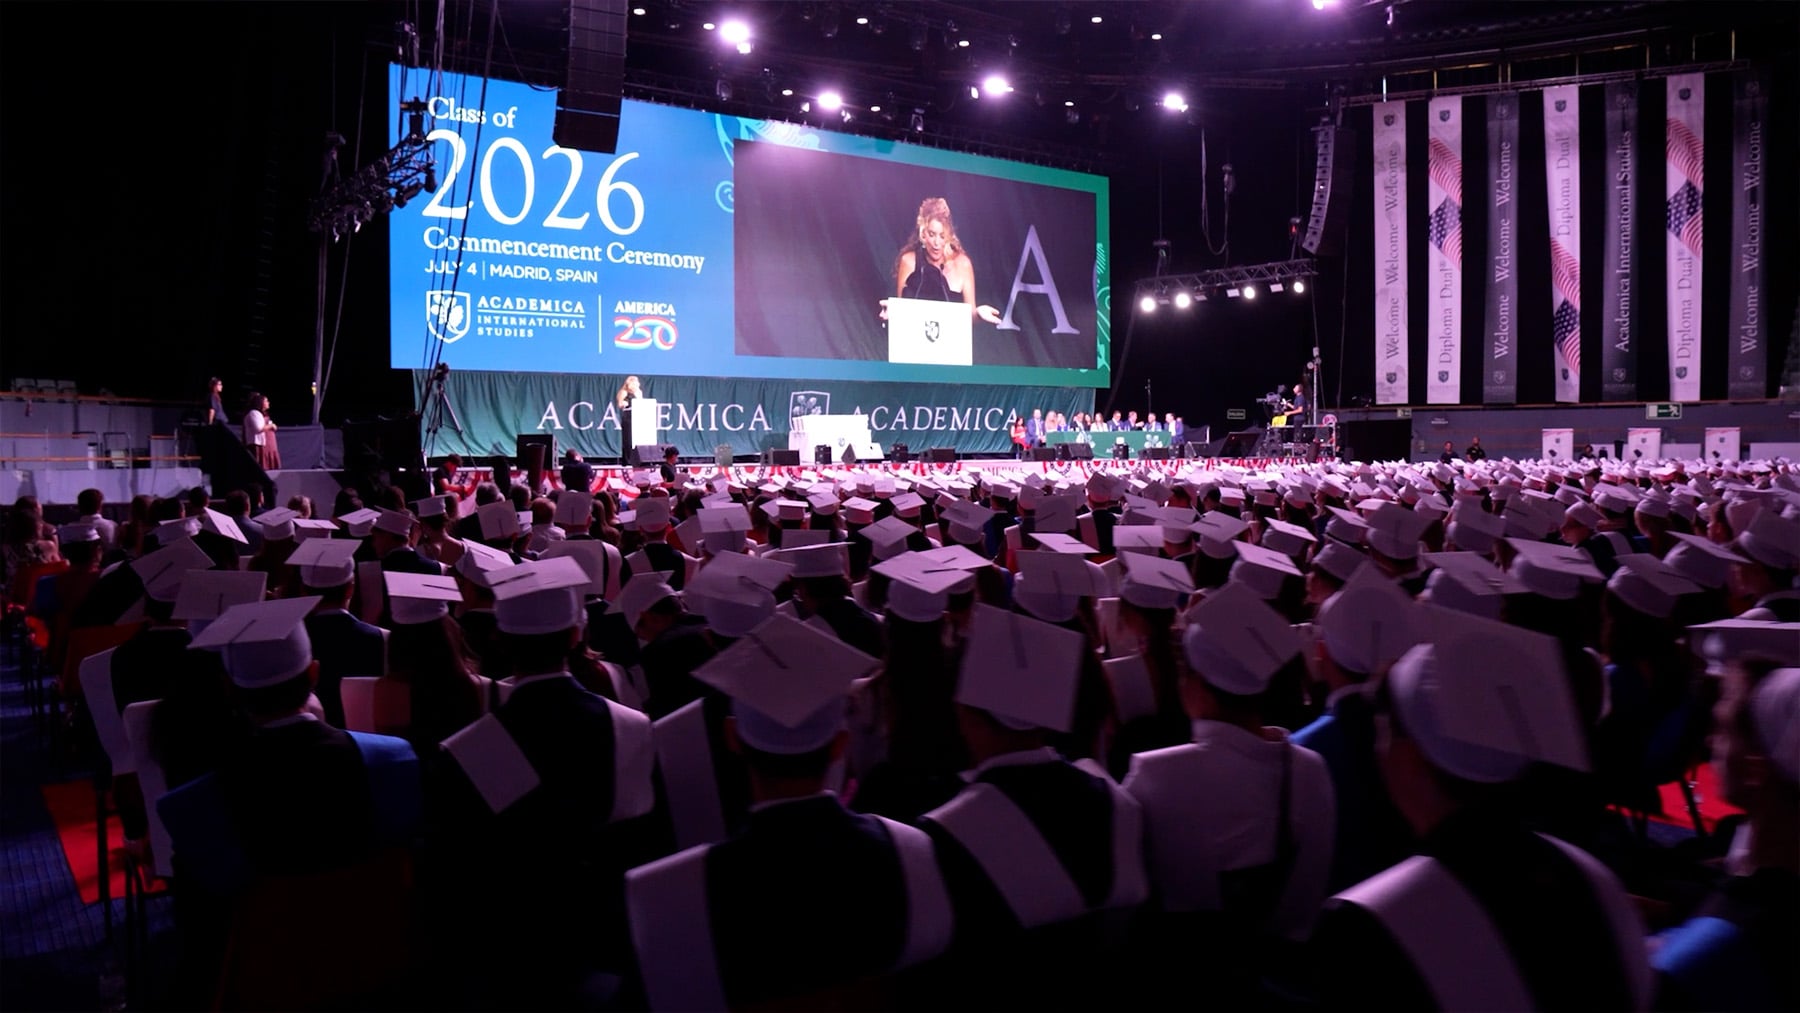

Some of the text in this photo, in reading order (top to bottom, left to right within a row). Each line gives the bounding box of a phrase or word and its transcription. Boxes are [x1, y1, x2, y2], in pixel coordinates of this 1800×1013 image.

[428, 96, 518, 129] Class of
[422, 129, 645, 235] 2026
[1557, 178, 1573, 236] Diploma
[423, 226, 705, 274] Commencement Ceremony
[1385, 149, 1399, 359] Welcome Welcome Welcome
[1494, 141, 1511, 359] Welcome Welcome Welcome
[1614, 131, 1632, 352] Academica International Studies
[1741, 121, 1760, 354] Welcome Welcome Welcome
[466, 262, 478, 276] 4
[489, 263, 553, 282] MADRID,
[555, 268, 599, 284] SPAIN
[996, 224, 1080, 335] A
[477, 296, 586, 314] ACADEMICA
[477, 315, 586, 329] INTERNATIONAL
[614, 300, 677, 316] AMERICA
[1677, 299, 1694, 359] Diploma
[477, 327, 535, 338] STUDIES
[613, 315, 679, 351] 250
[1440, 308, 1454, 364] Diploma
[536, 401, 773, 431] ACAEMICA
